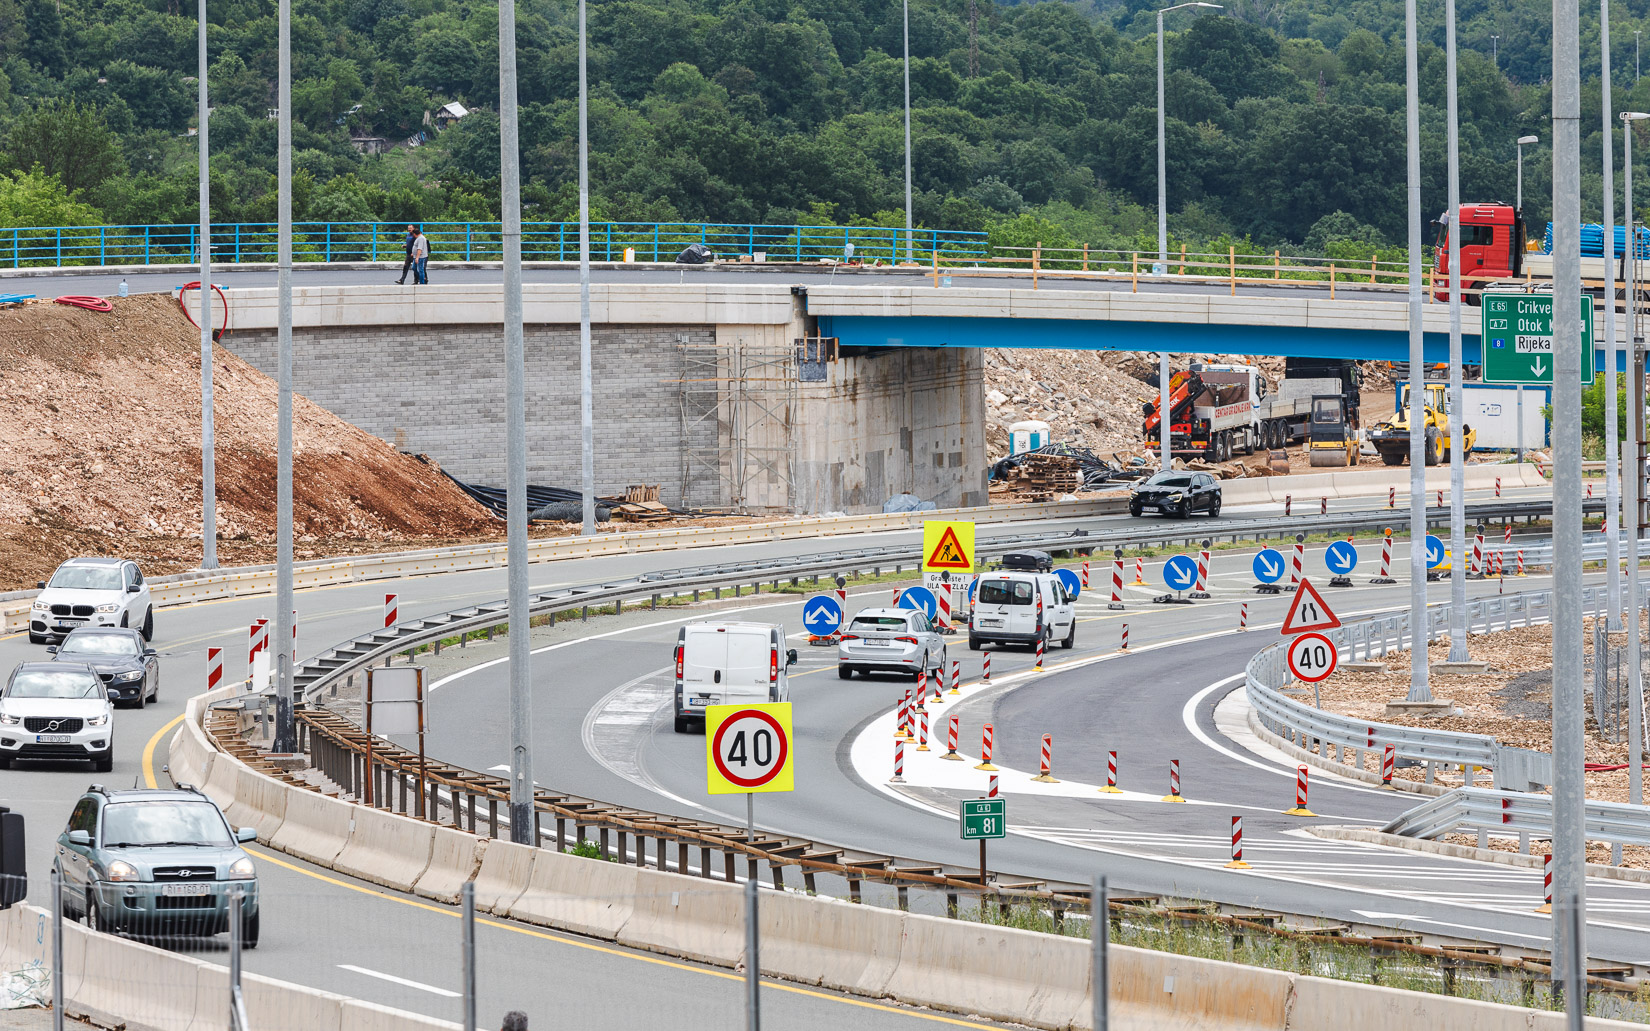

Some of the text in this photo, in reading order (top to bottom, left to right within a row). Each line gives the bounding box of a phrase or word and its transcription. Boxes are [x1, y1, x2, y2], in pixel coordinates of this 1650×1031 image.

[1491, 302, 1506, 311] E 65
[1517, 300, 1553, 314] Crikve
[1493, 320, 1504, 328] A 7
[1518, 319, 1543, 332] Otok
[1496, 339, 1501, 348] 8
[1518, 336, 1551, 352] Rijeka
[1299, 645, 1327, 670] 40
[727, 729, 772, 767] 40
[966, 818, 996, 834] km 81
